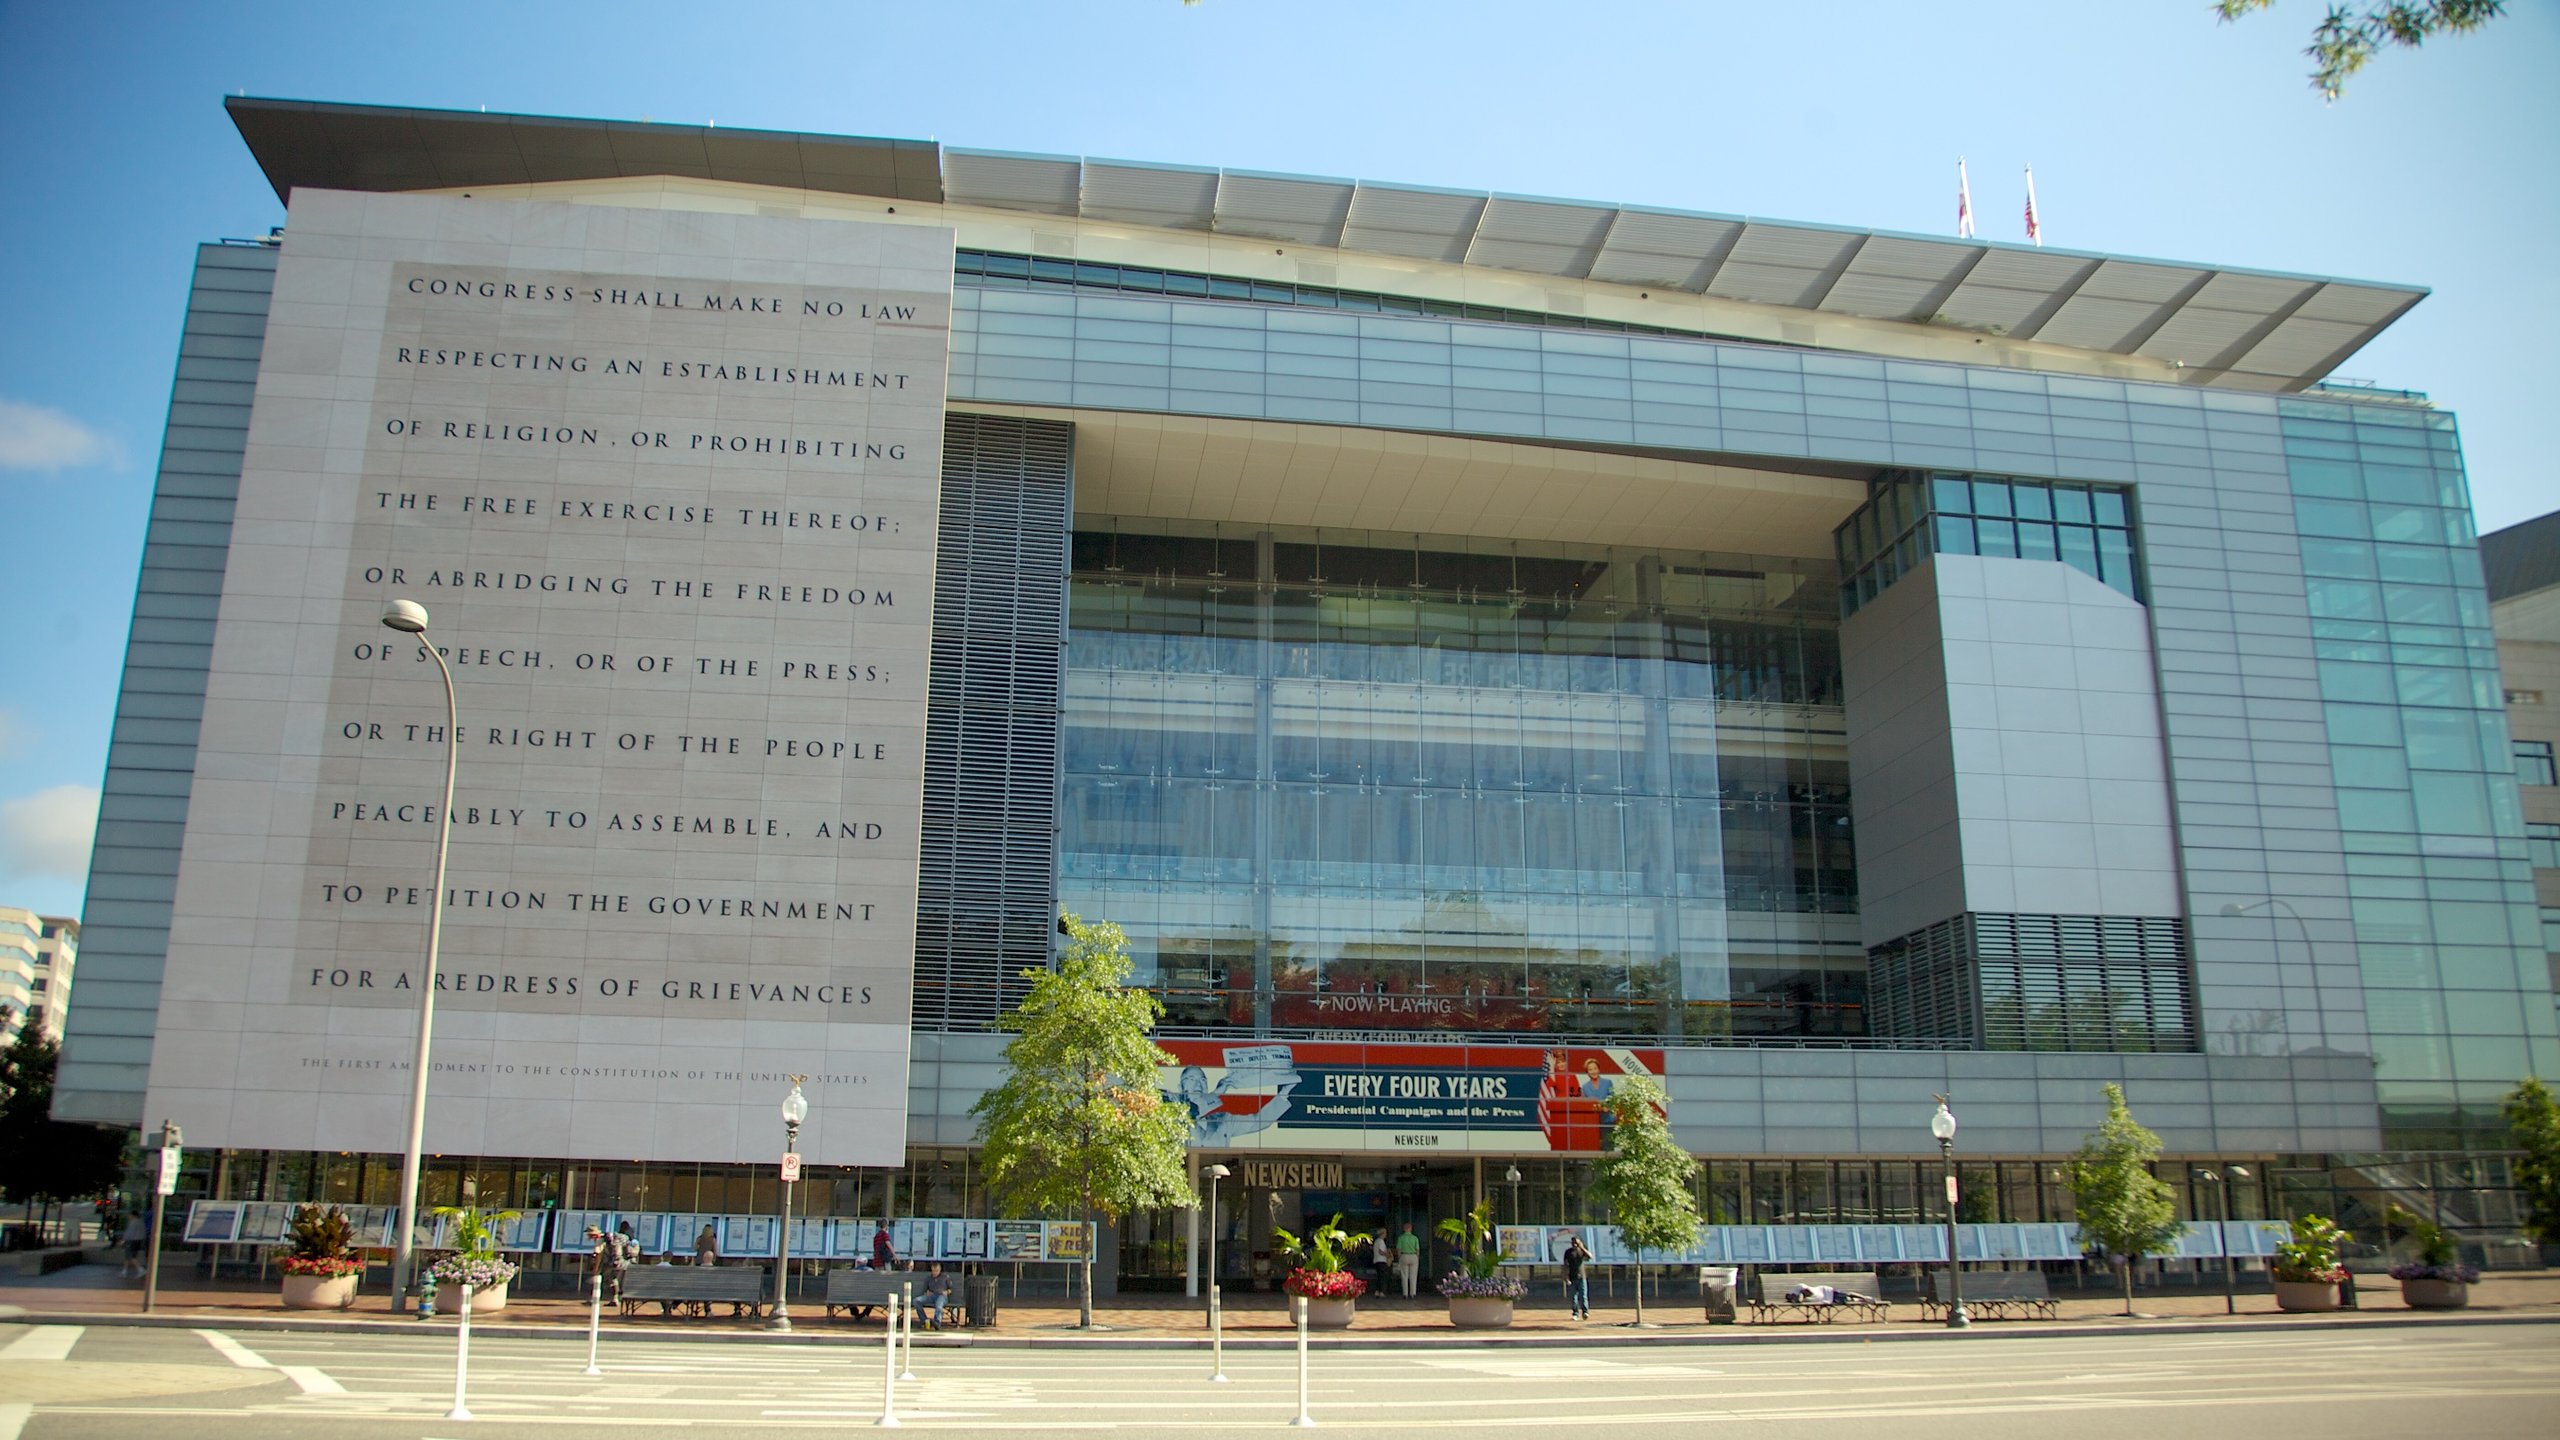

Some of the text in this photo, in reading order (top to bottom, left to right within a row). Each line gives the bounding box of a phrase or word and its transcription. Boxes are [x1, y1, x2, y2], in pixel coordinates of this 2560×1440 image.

[408, 278, 916, 322] CONGRESS SHALL MAKE NO LAW
[397, 347, 909, 390] RESPECTING AN ESTABLISHMENT
[386, 419, 905, 460] OF RELIGION, OR PROHIBITING
[376, 492, 900, 534] THE FREE EXERCISE THEREOF;
[364, 567, 894, 607] OR ABRIDGING THE FREEDOM
[353, 643, 890, 684] OF SPEECH, OR OF THE PRESS;
[343, 722, 885, 761] OR THE RIGHT OF THE PEOPLE
[545, 810, 587, 829] TO
[606, 813, 791, 839] ASSEMBLE,
[815, 821, 883, 840] AND
[322, 884, 363, 903] TO
[567, 893, 629, 913] THE
[648, 896, 876, 921] GOVERNMENT
[311, 968, 872, 1005] FOR A REDRESS OF GRIEVANCES
[1332, 996, 1452, 1013] NOW PLAYING
[302, 1057, 329, 1068] THE
[338, 1059, 381, 1069] FIRST
[389, 1060, 487, 1074] AMDMENT
[495, 1064, 515, 1074] TO
[523, 1065, 551, 1076] THE
[559, 1066, 679, 1079] CONSTITUTION
[687, 1070, 704, 1080] OF
[714, 1071, 741, 1081] THE
[816, 1074, 868, 1084] STATES
[1324, 1074, 1508, 1099] EVERY FOUR YEARS
[1306, 1103, 1525, 1118] Presidential Campaigns and the Press
[1394, 1134, 1439, 1146] NEWSEUM
[1243, 1162, 1343, 1189] NEWSEUM
